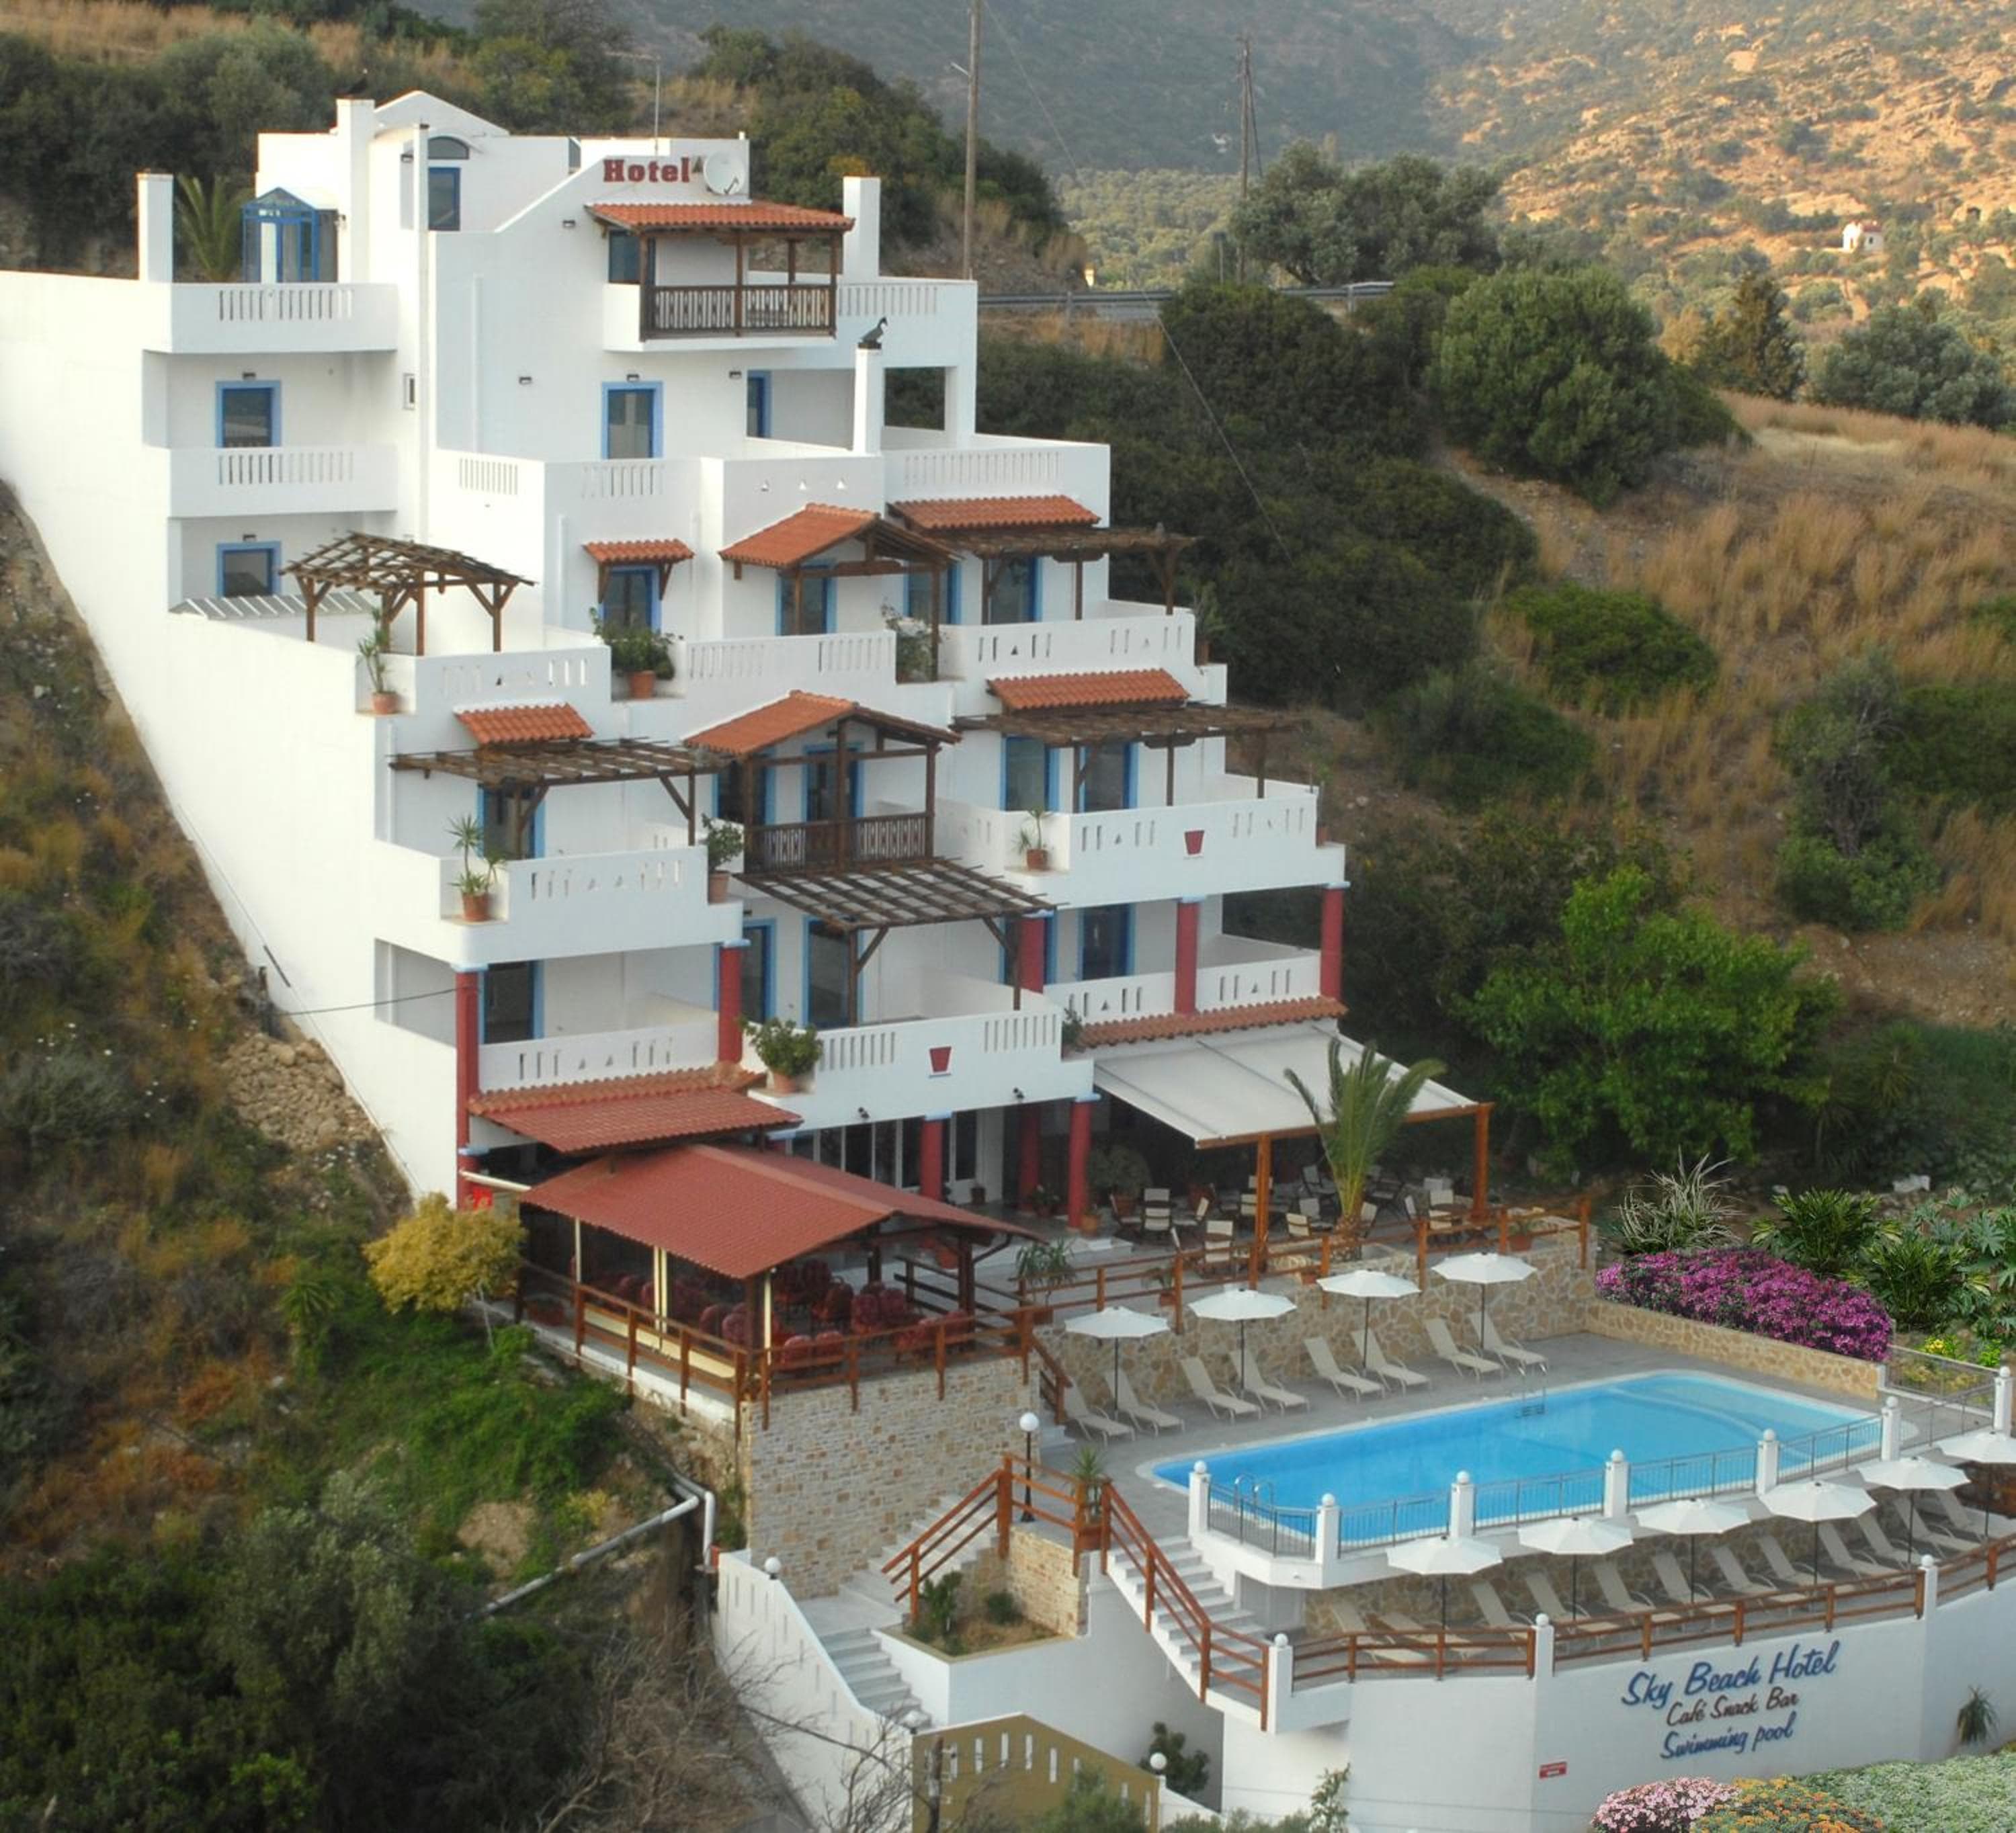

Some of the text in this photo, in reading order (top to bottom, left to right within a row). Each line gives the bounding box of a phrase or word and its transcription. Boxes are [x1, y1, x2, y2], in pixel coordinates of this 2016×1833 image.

[603, 157, 689, 183] Hotel
[1621, 1639, 1841, 1709] Sky Beach Hotel
[1711, 1695, 1759, 1718] Snack
[1765, 1686, 1800, 1710] Bar
[1660, 1711, 1798, 1759] Swimming pool
